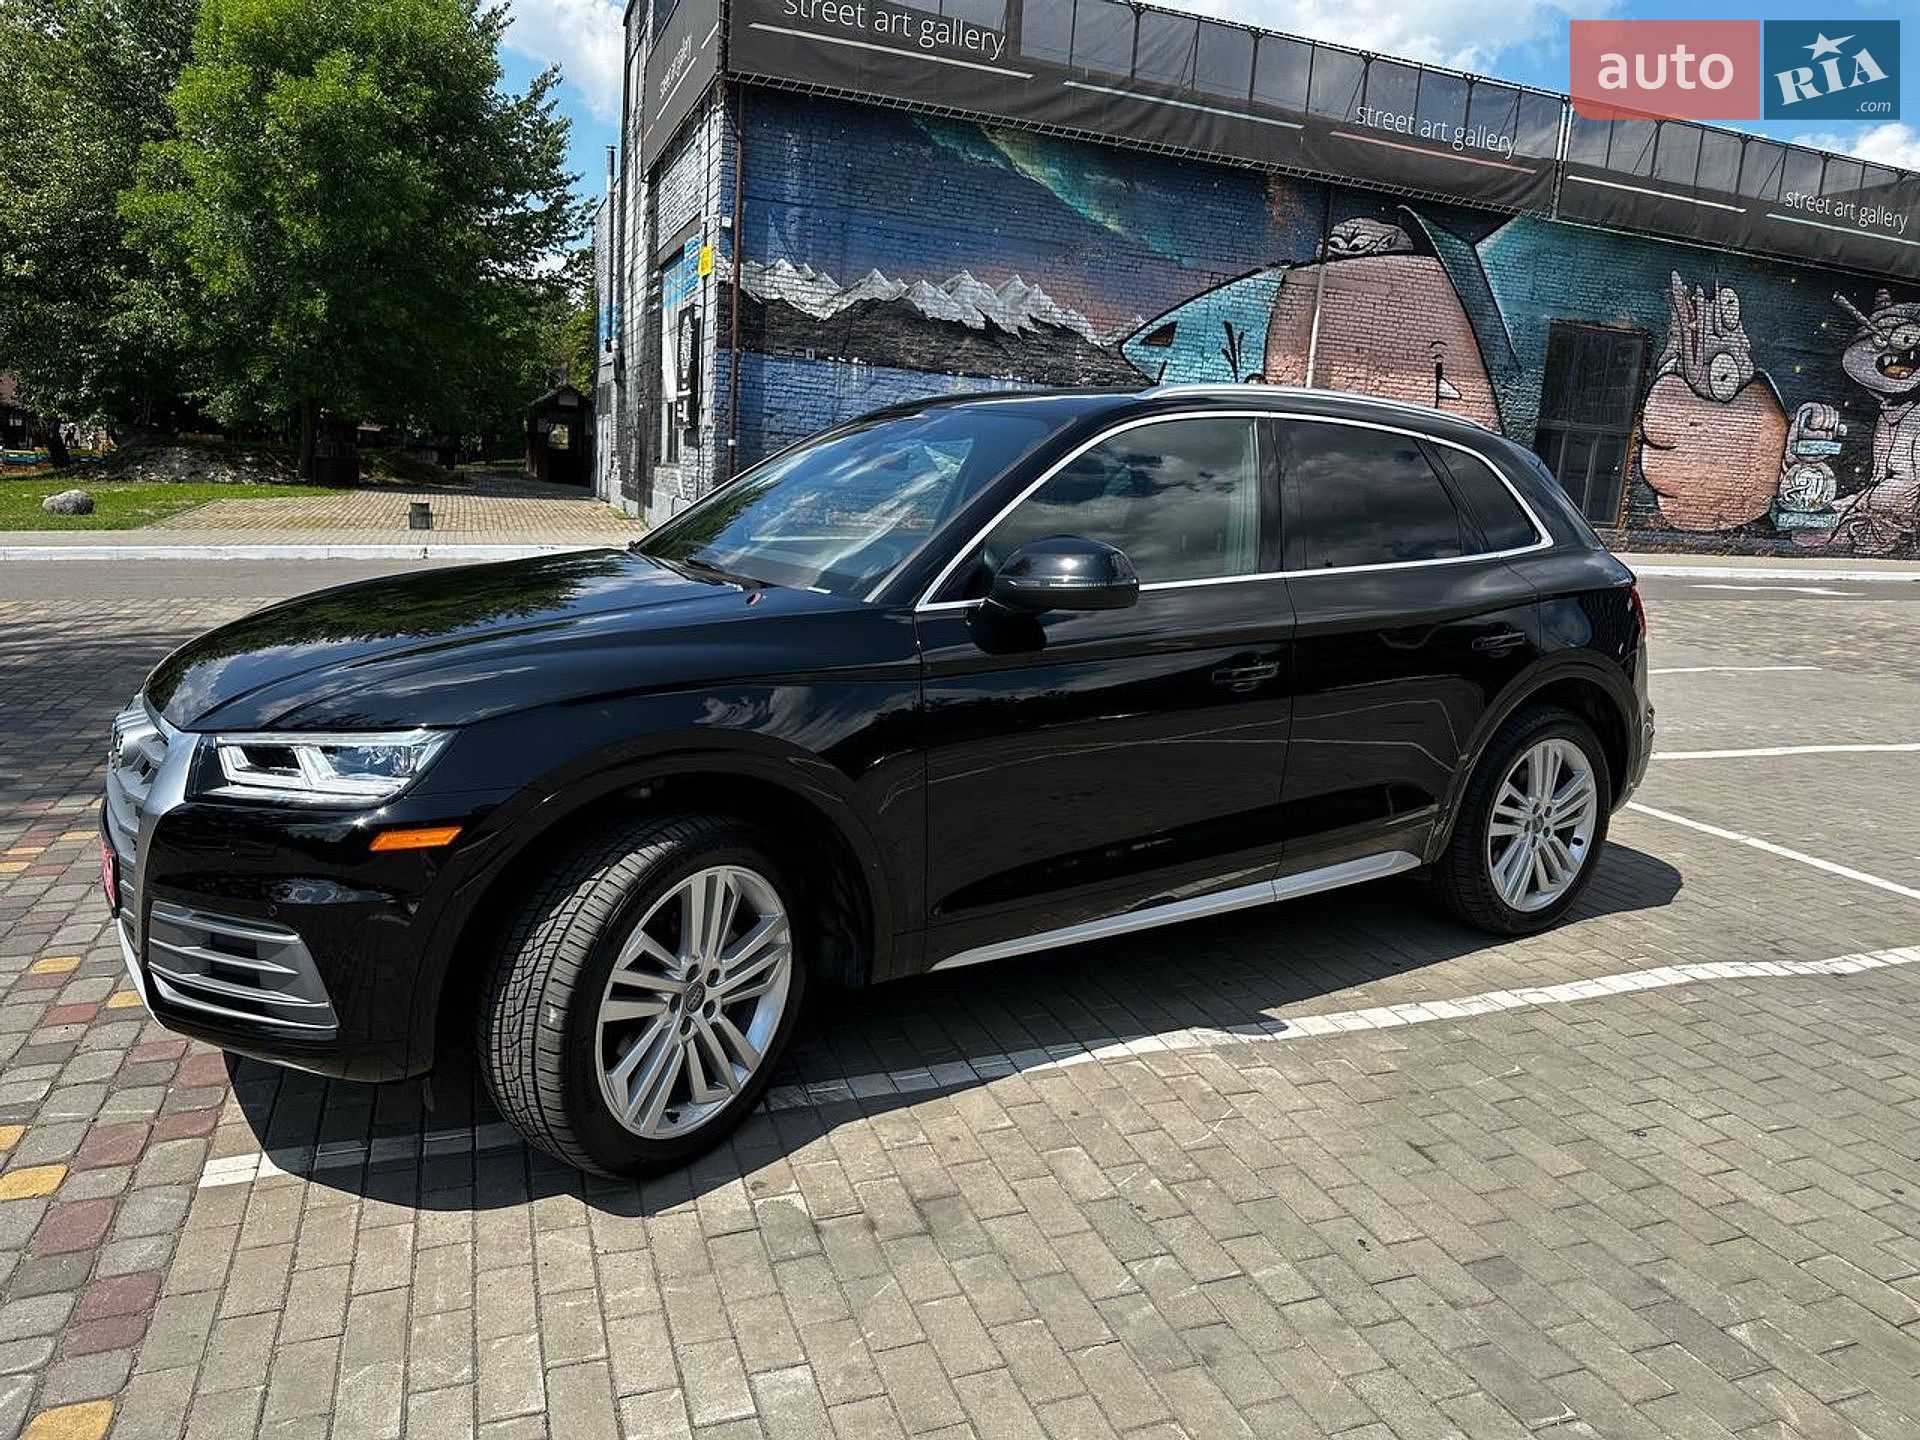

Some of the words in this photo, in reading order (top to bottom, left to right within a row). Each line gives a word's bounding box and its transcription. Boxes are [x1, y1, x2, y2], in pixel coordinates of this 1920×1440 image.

[783, 0, 865, 28] street
[874, 10, 912, 37] art
[919, 18, 1006, 60] gallery
[1355, 105, 1415, 135] street
[1420, 119, 1448, 142] art
[1452, 125, 1518, 160] gallery
[1785, 191, 1830, 215] street
[1834, 201, 1855, 220] art
[1859, 204, 1908, 235] gallery
